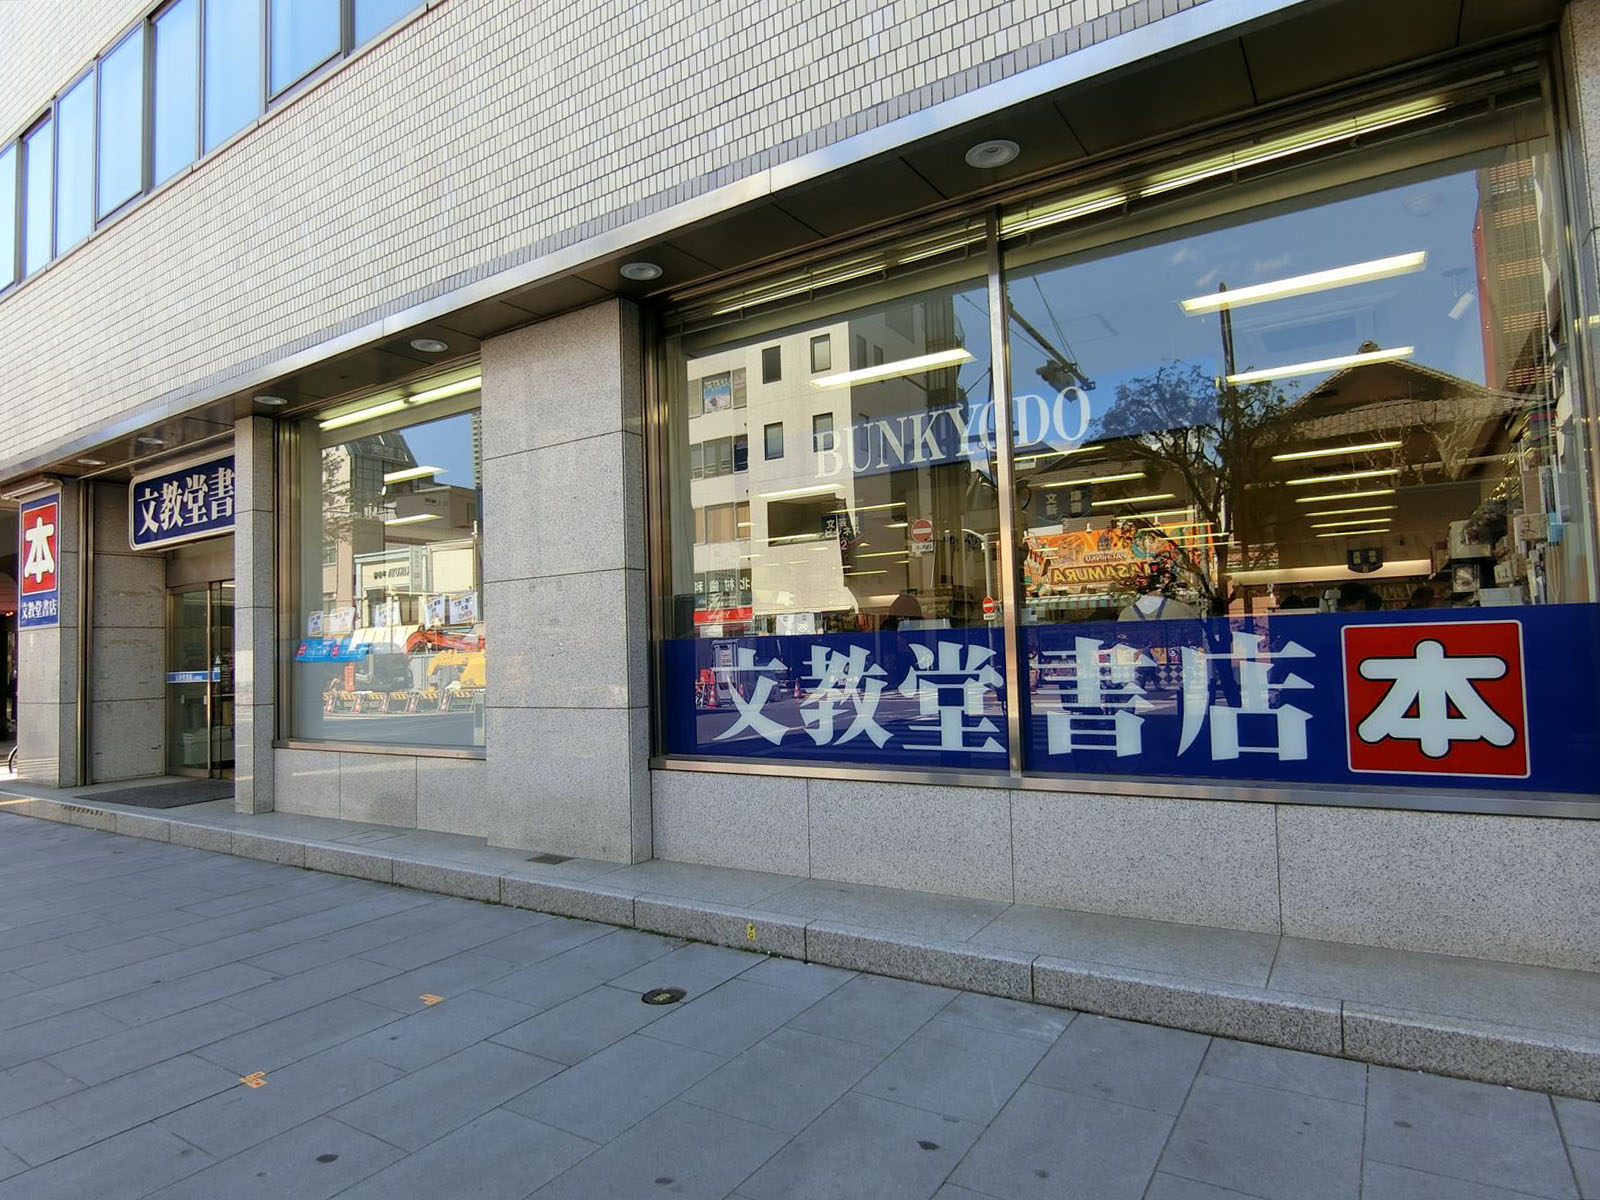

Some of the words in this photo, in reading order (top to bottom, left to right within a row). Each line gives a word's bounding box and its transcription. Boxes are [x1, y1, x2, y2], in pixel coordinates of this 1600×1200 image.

[137, 467, 235, 536] 文教堂書
[25, 516, 54, 584] 本
[21, 598, 57, 620] 文教堂書店
[711, 631, 1317, 761] 文教堂書店
[1358, 640, 1515, 758] 本
